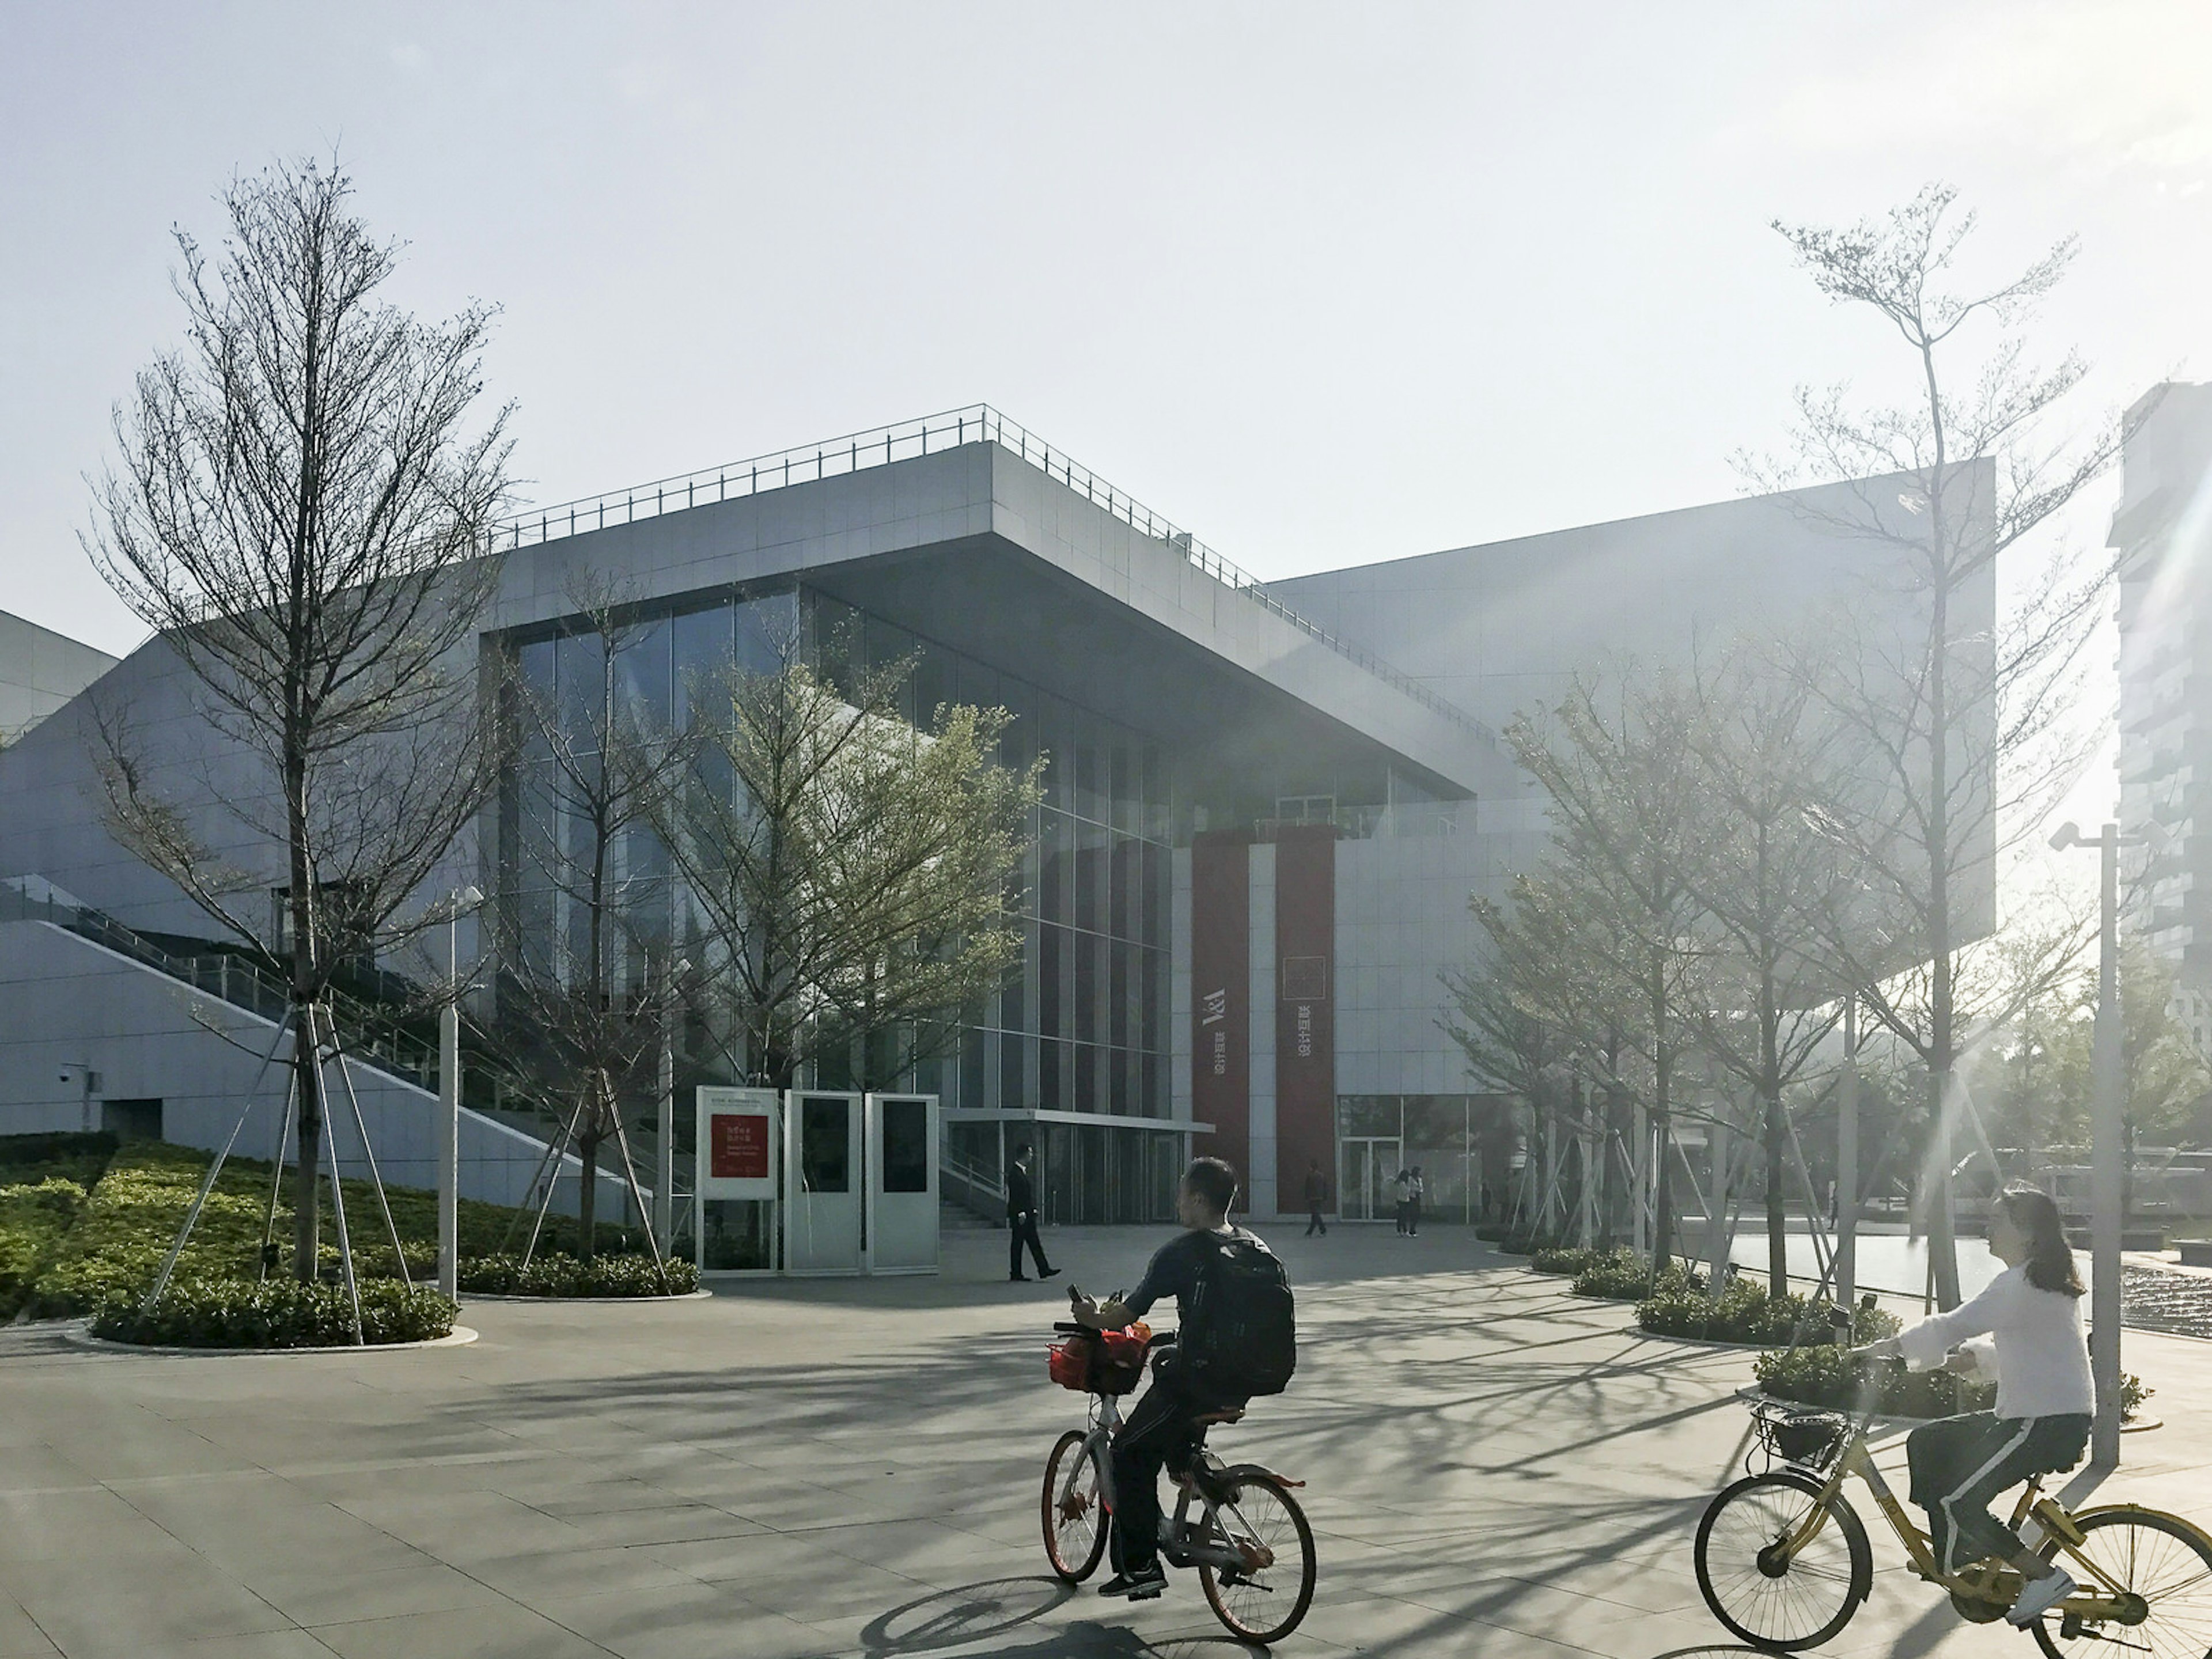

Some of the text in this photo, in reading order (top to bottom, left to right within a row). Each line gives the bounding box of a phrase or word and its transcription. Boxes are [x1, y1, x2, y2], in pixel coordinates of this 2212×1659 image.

[1214, 1031, 1226, 1075] 设计互联
[1297, 1005, 1312, 1058] 设计互联
